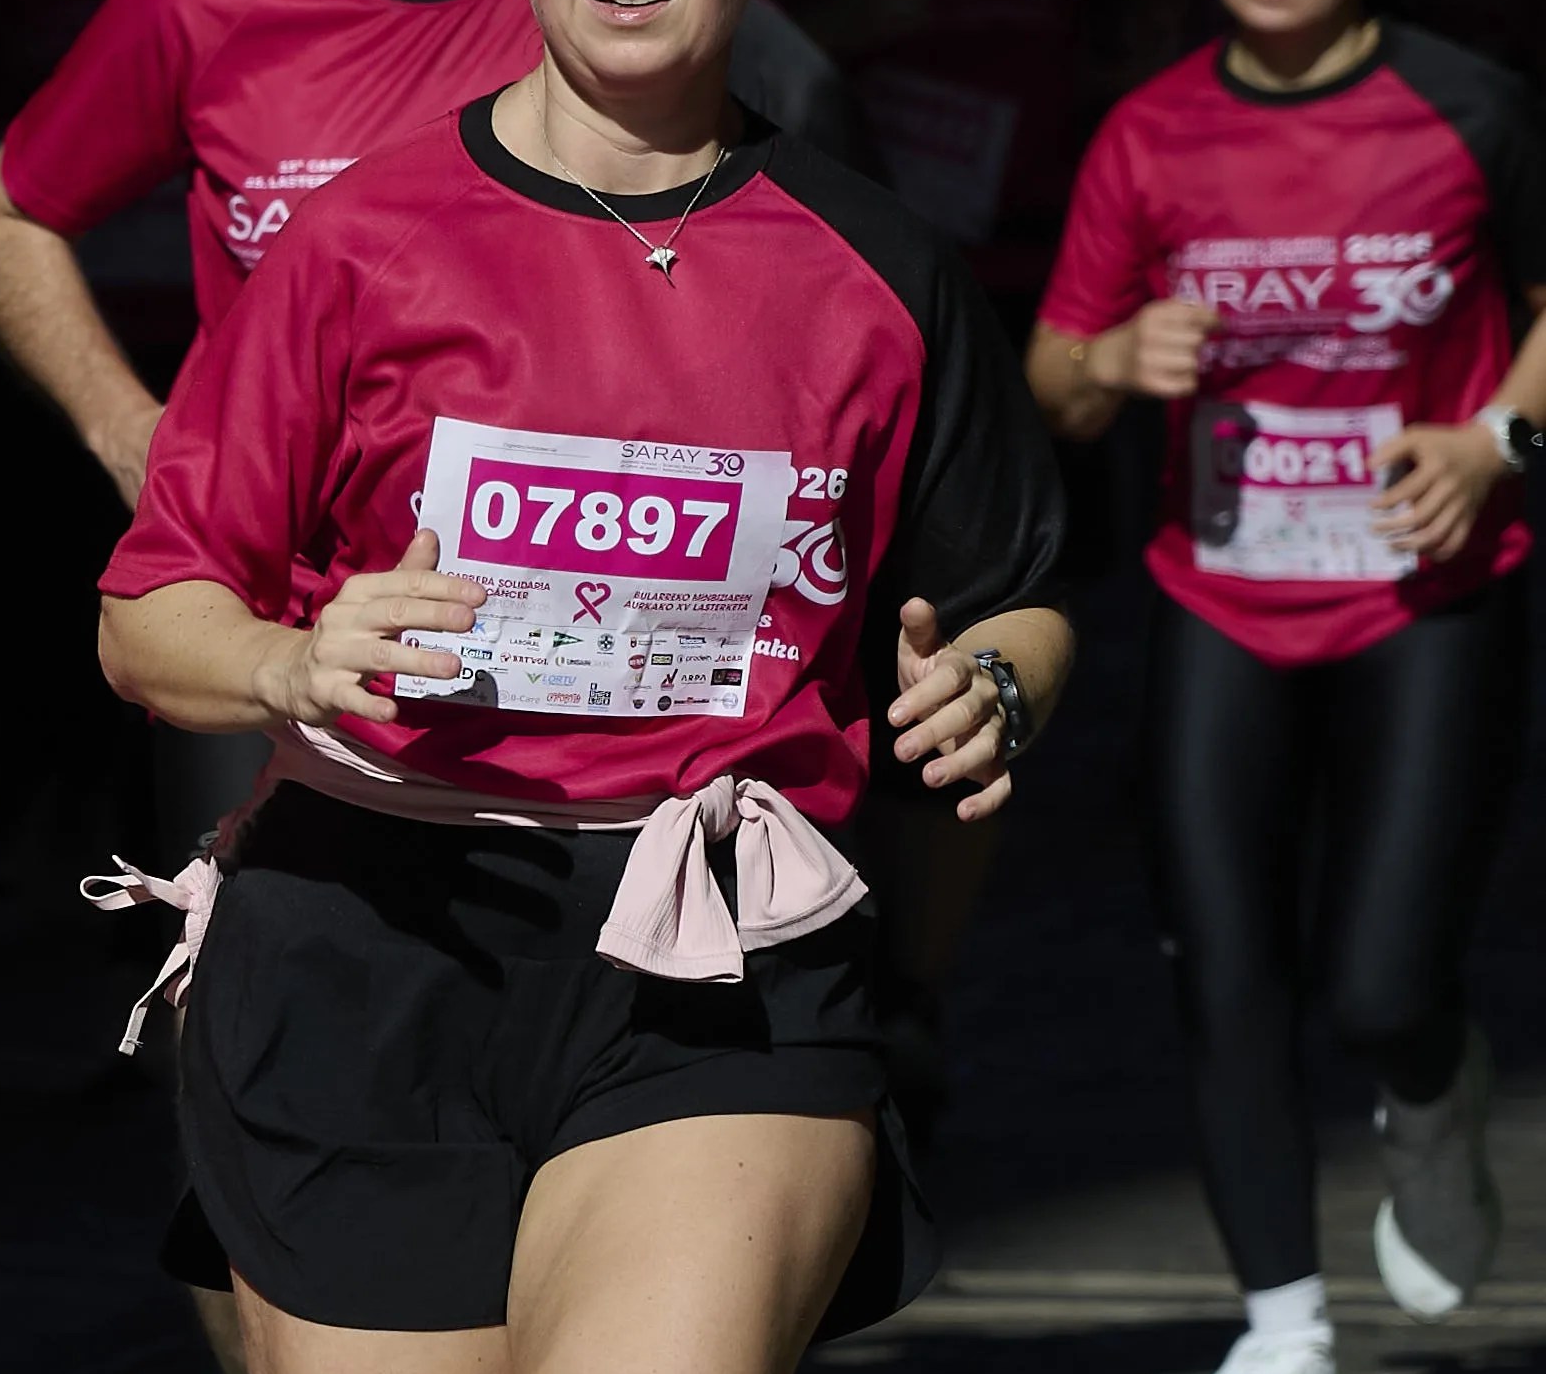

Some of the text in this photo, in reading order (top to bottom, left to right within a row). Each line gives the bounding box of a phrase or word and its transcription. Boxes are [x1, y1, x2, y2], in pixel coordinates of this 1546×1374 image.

[1346, 261, 1456, 334] 30
[620, 442, 702, 465] SARAY
[470, 480, 731, 559] 07897
[498, 578, 551, 592] SOLIDARIA
[675, 602, 692, 612] XV
